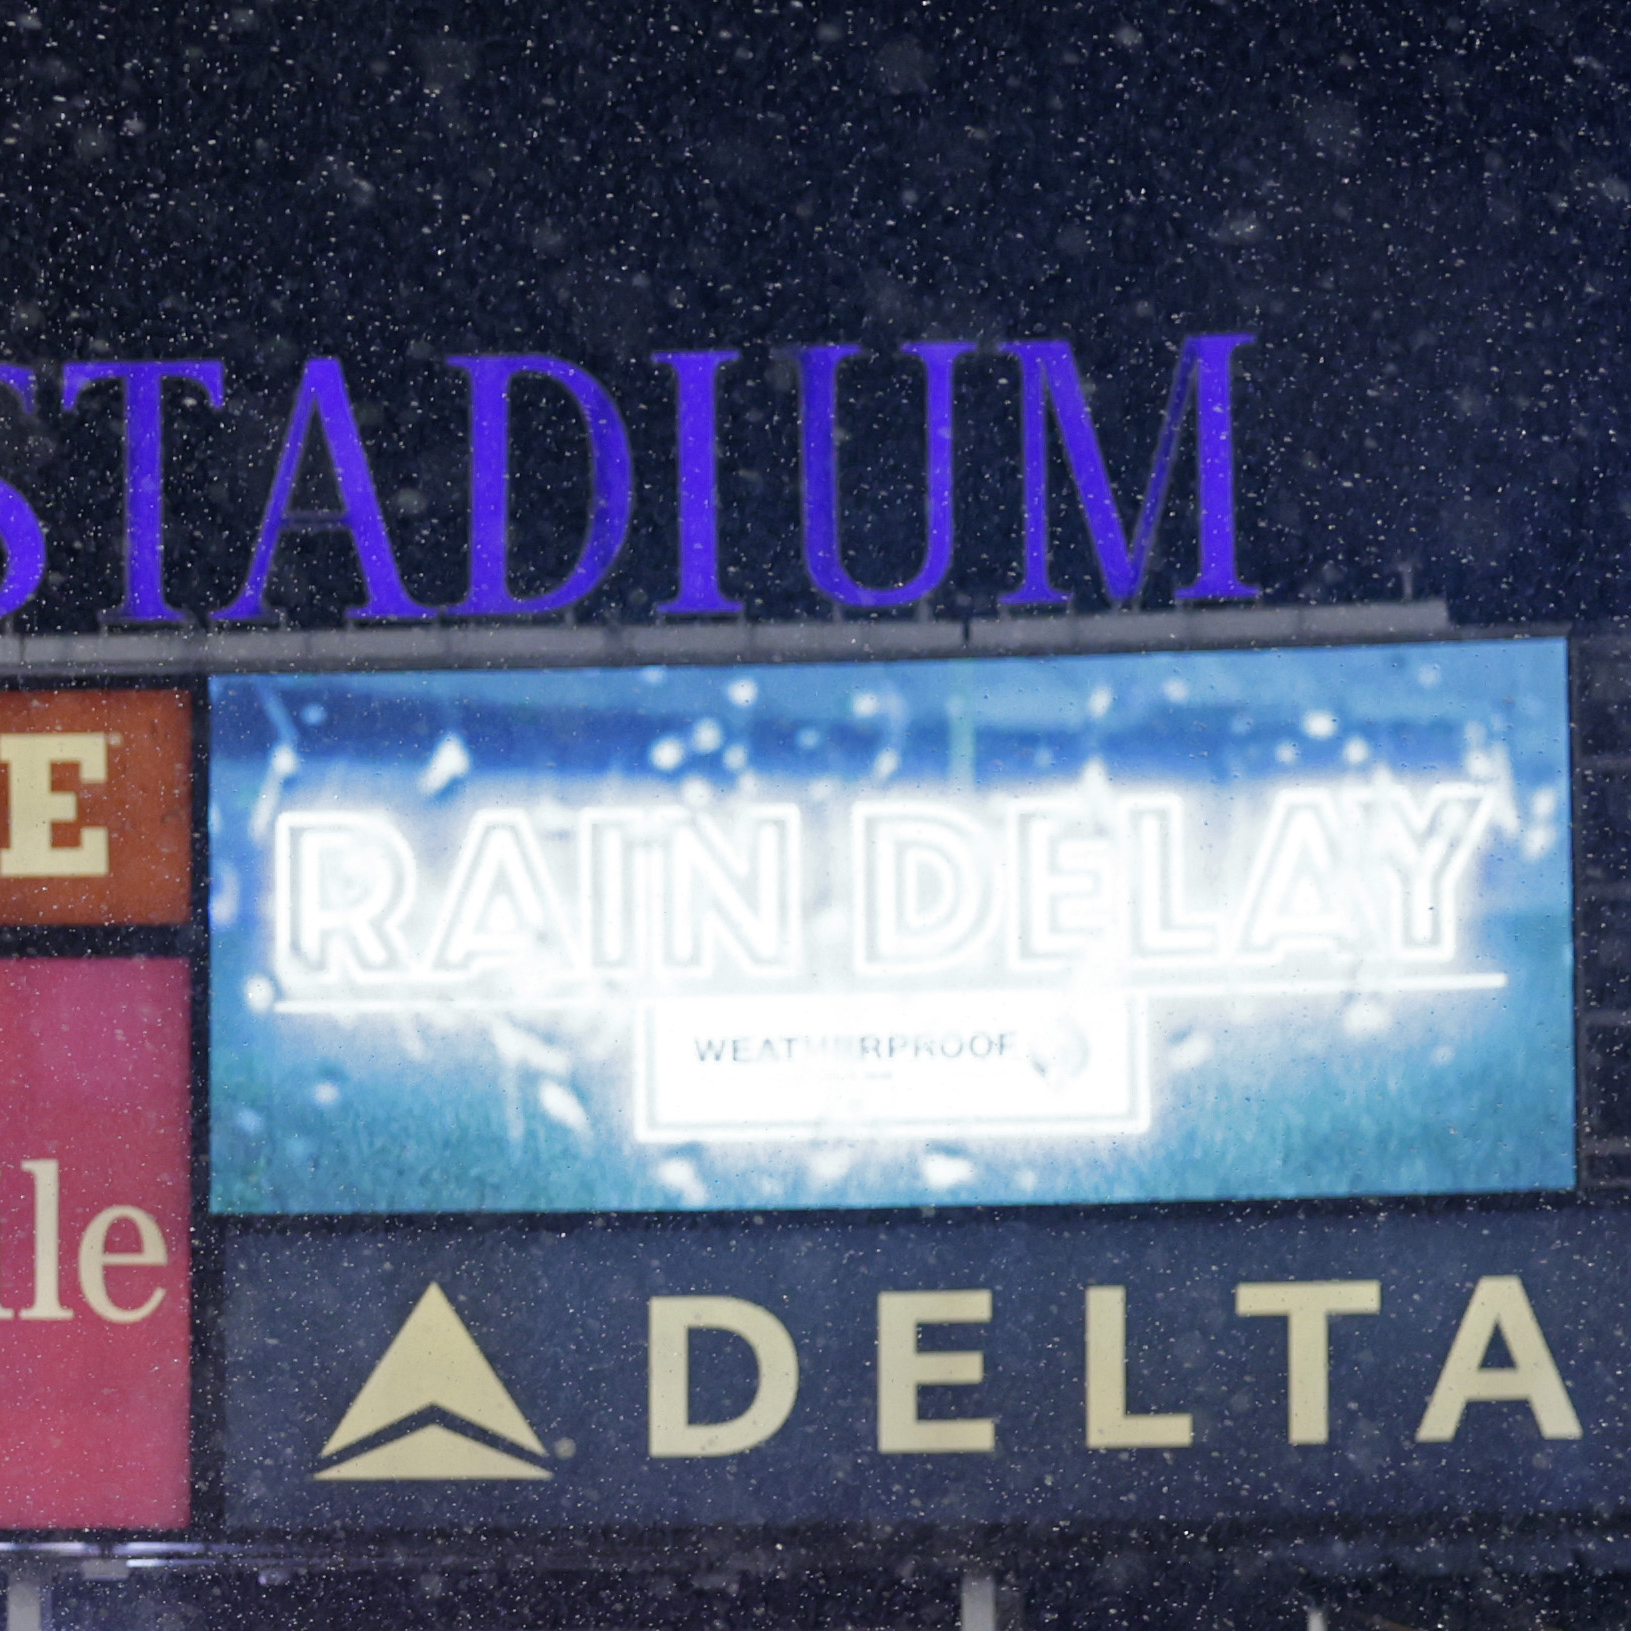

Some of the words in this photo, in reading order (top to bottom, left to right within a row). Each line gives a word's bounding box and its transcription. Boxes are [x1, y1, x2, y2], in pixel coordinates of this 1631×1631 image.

[276, 803, 802, 987] RAIN
[851, 783, 1501, 975] DELAY
[647, 1275, 1584, 1457] DELTA
